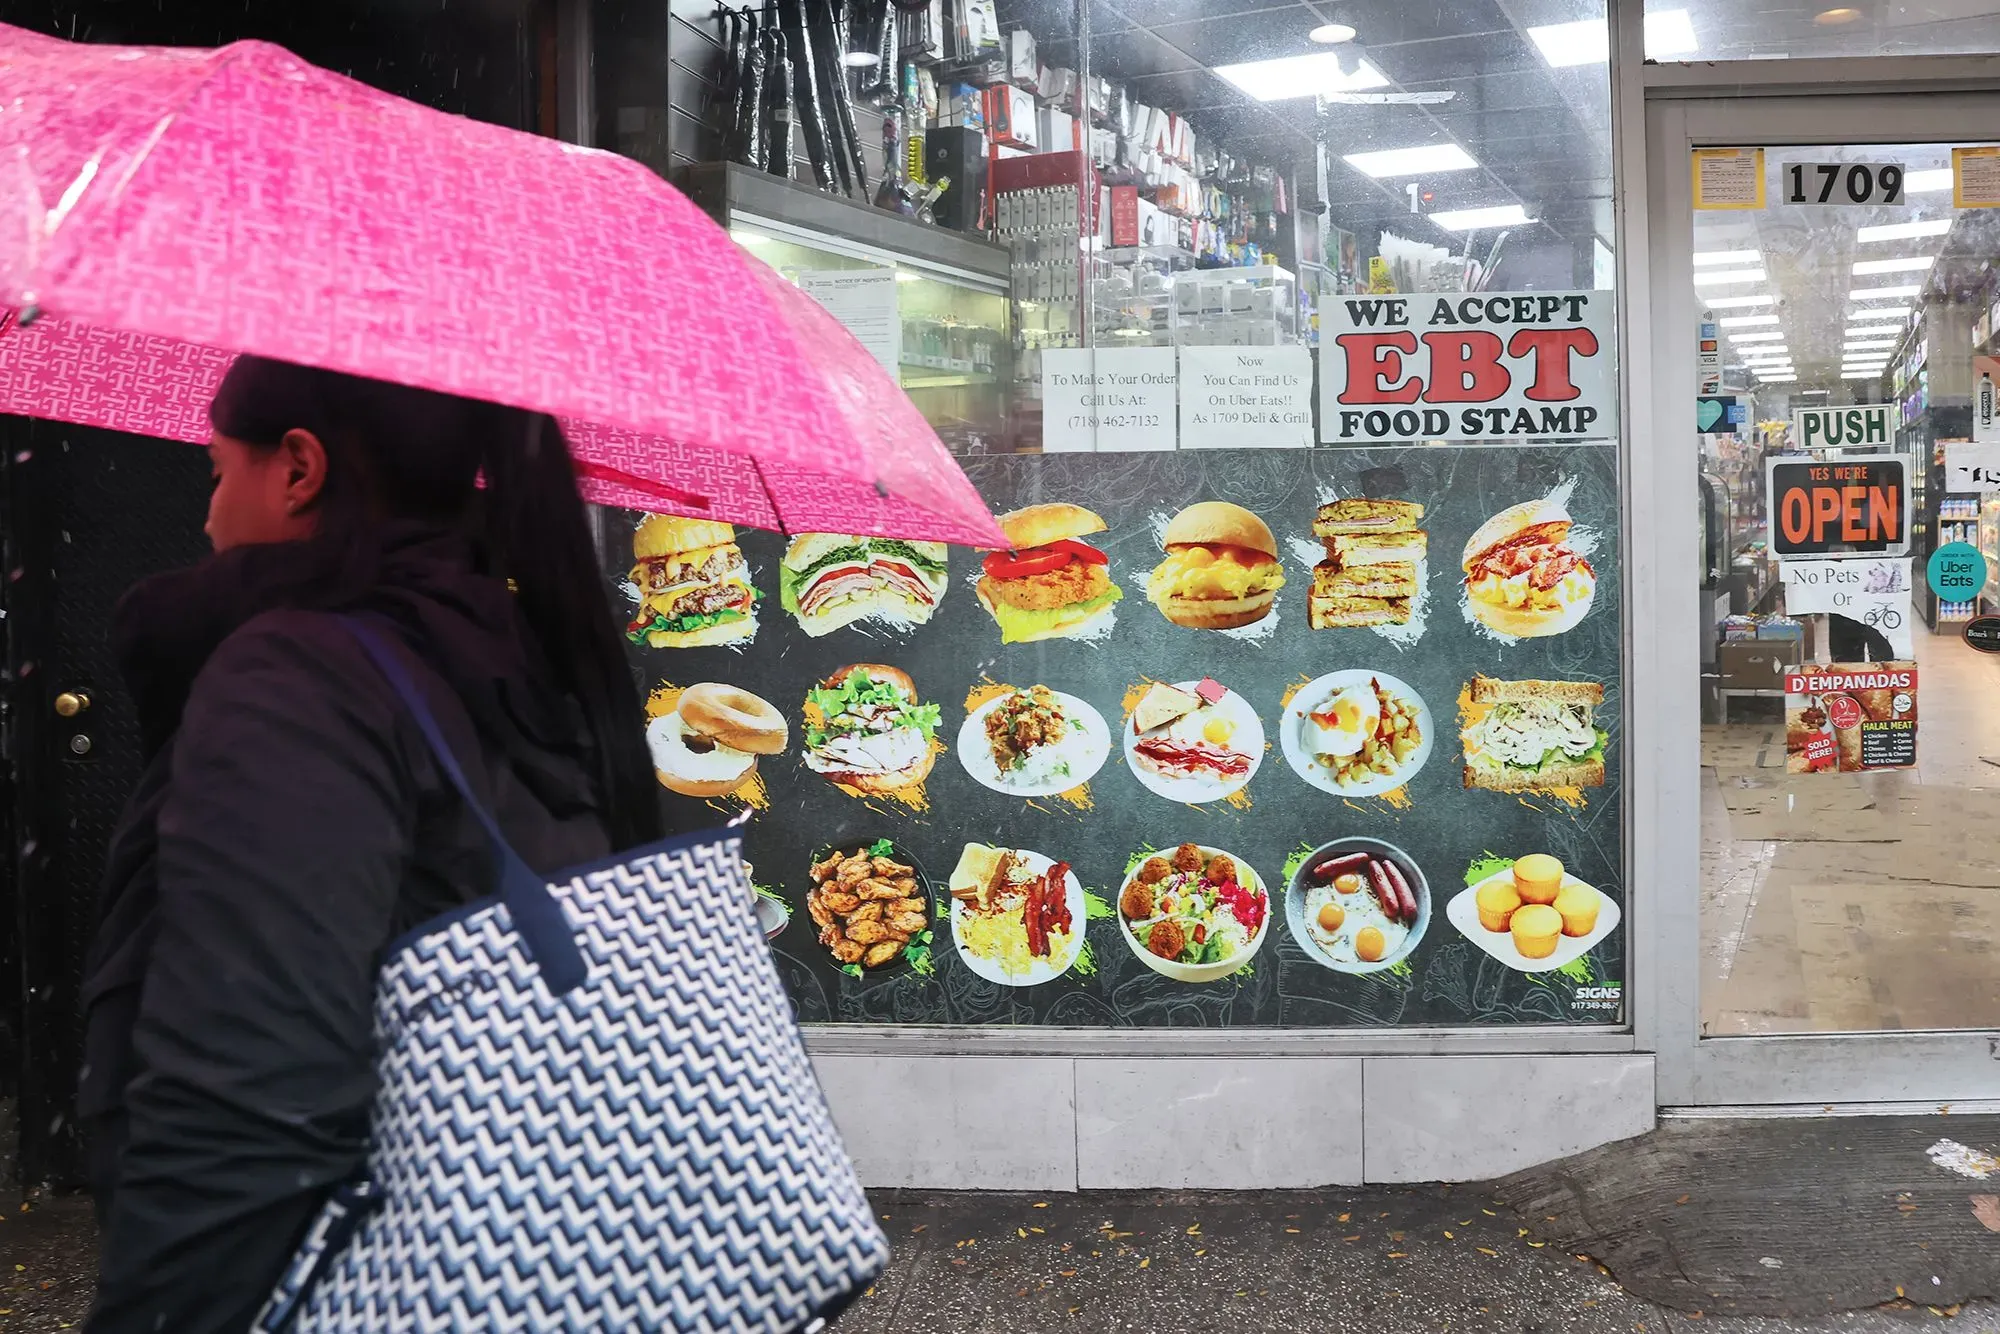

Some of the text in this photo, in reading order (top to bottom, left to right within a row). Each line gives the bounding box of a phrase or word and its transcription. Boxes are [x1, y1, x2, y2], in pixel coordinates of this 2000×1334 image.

[1790, 165, 1904, 202] 1709
[1345, 295, 1588, 326] WE ACCEPT
[1237, 356, 1264, 366] Now
[1335, 327, 1599, 404] EBT
[1051, 373, 1176, 385] To Make Your Order
[1203, 375, 1298, 385] You Can Find Us
[1080, 395, 1146, 406] Call Us At:
[1209, 395, 1292, 406] On Uber Eats!!
[1068, 416, 1159, 429] (718) 462-7132
[1193, 413, 1309, 424] As 1709 Deli & Grill
[1339, 407, 1598, 437] FOOD STAMP
[1803, 409, 1885, 446] PUSH
[1810, 467, 1868, 481] YES WE'RE
[1781, 486, 1897, 544] OPEN
[1941, 561, 1974, 572] Uber
[1793, 568, 1860, 584] No Pets
[1940, 575, 1973, 586] Eats
[1833, 592, 1852, 606] Or
[1863, 721, 1913, 730] HALAL MEAT
[1808, 739, 1830, 751] SOLD
[1809, 748, 1832, 760] HERE!
[1576, 988, 1621, 998] SIGNS
